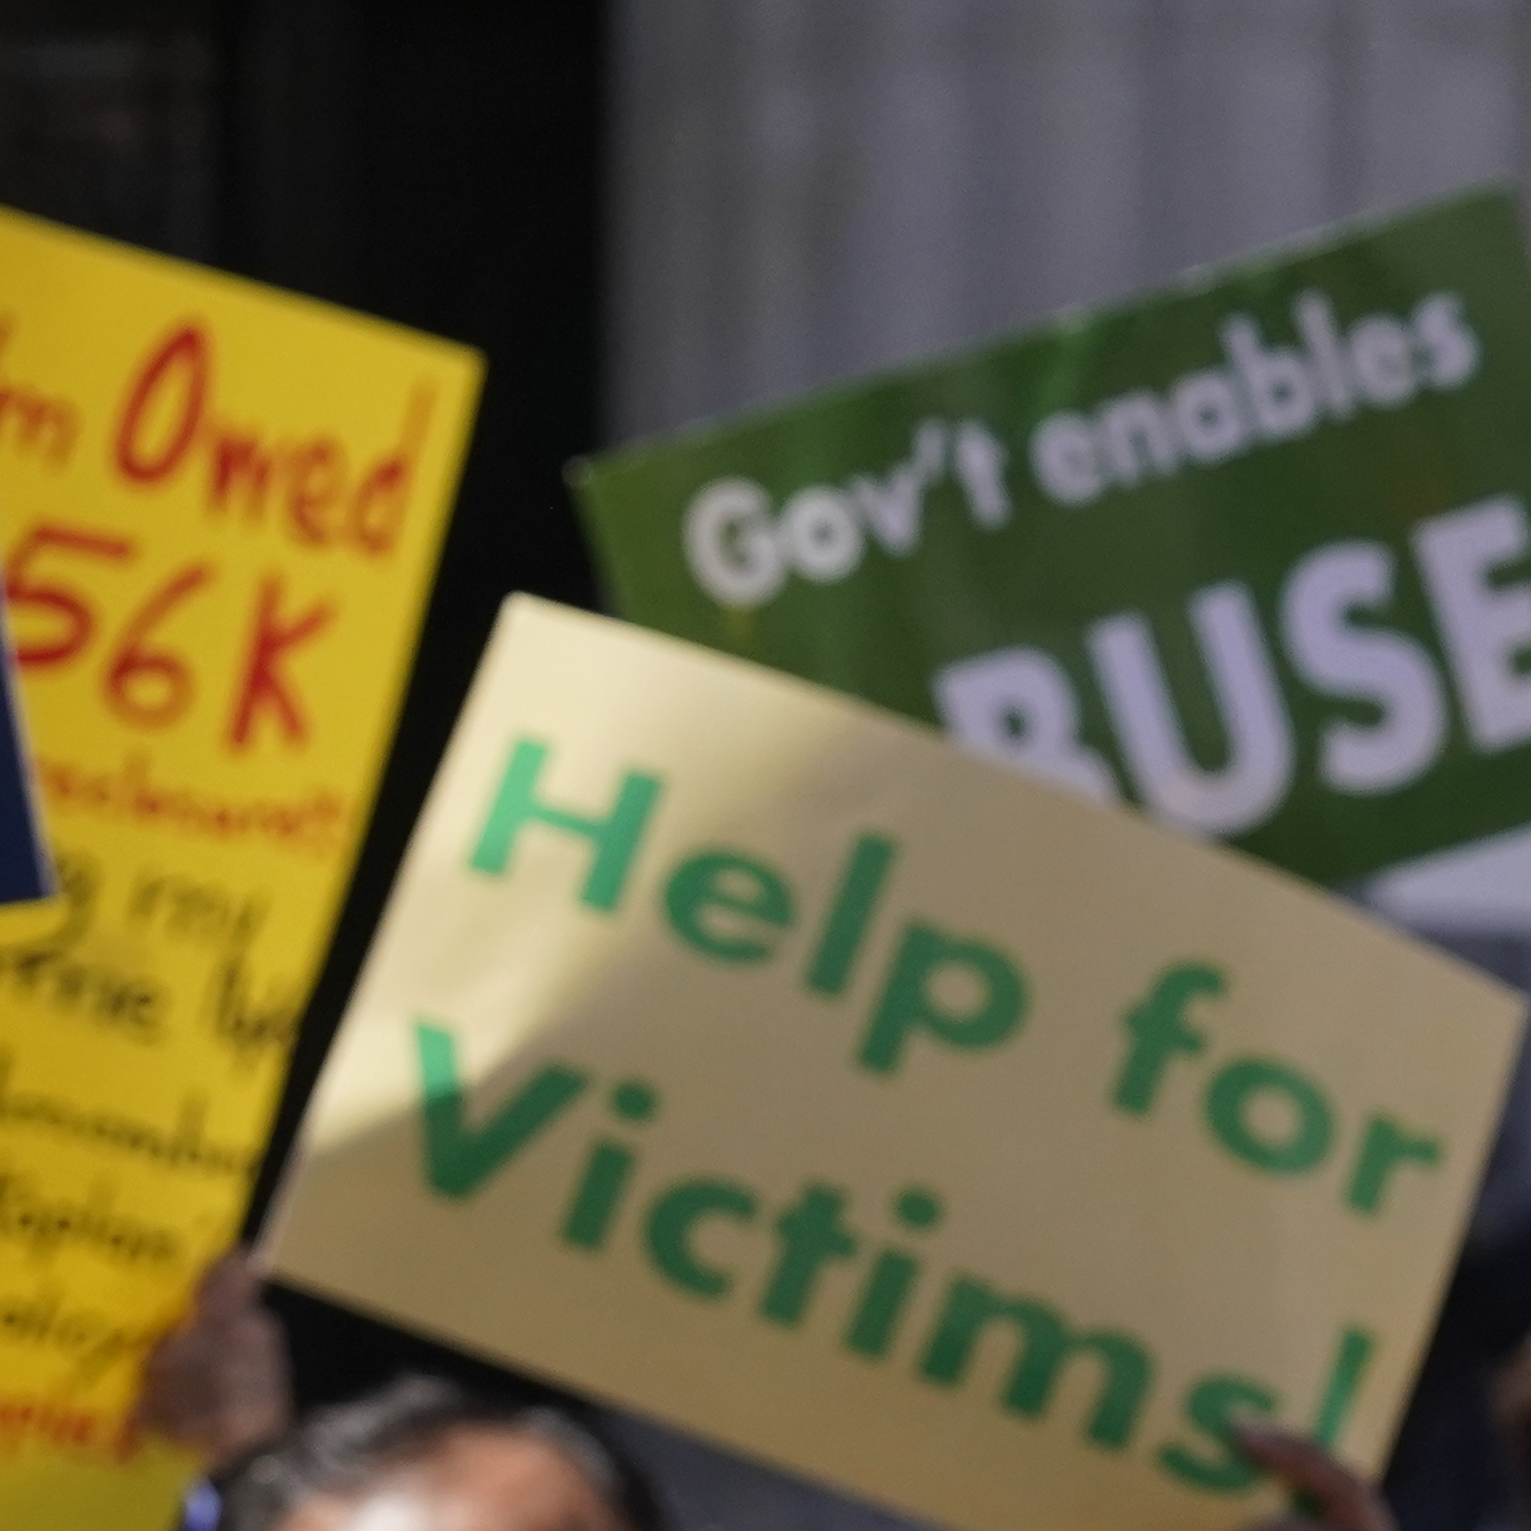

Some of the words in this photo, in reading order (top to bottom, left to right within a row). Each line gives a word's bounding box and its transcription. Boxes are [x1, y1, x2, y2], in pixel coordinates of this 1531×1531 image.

[110, 314, 441, 568] Owed
[681, 416, 1014, 608] Gov't
[1028, 289, 1482, 507] enables
[465, 731, 1034, 1080] Help
[1110, 958, 1446, 1218] for
[410, 1015, 1380, 1518] Victims!
